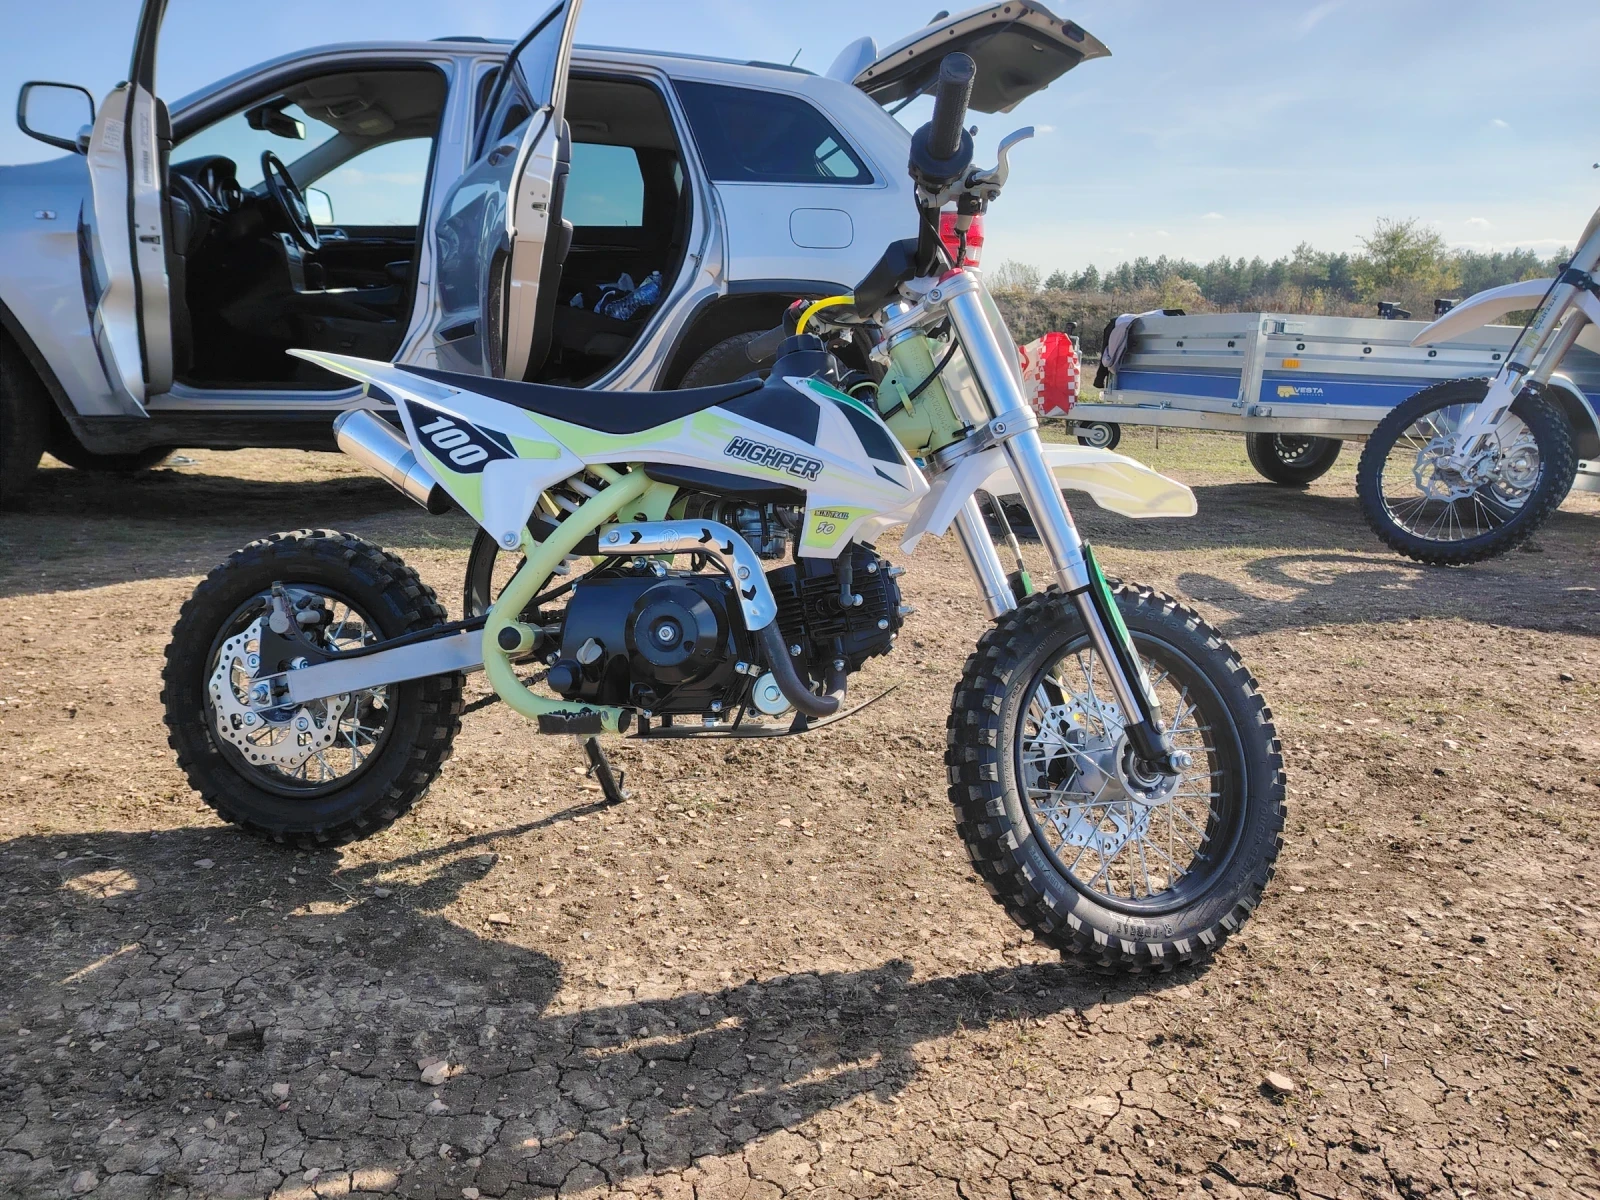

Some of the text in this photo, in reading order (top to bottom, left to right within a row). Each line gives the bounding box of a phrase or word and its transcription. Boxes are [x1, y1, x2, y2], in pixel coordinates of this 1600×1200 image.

[418, 415, 490, 466] 100
[723, 434, 824, 482] HIGHPER
[815, 521, 836, 535] 50
[829, 510, 849, 520] TRAIL
